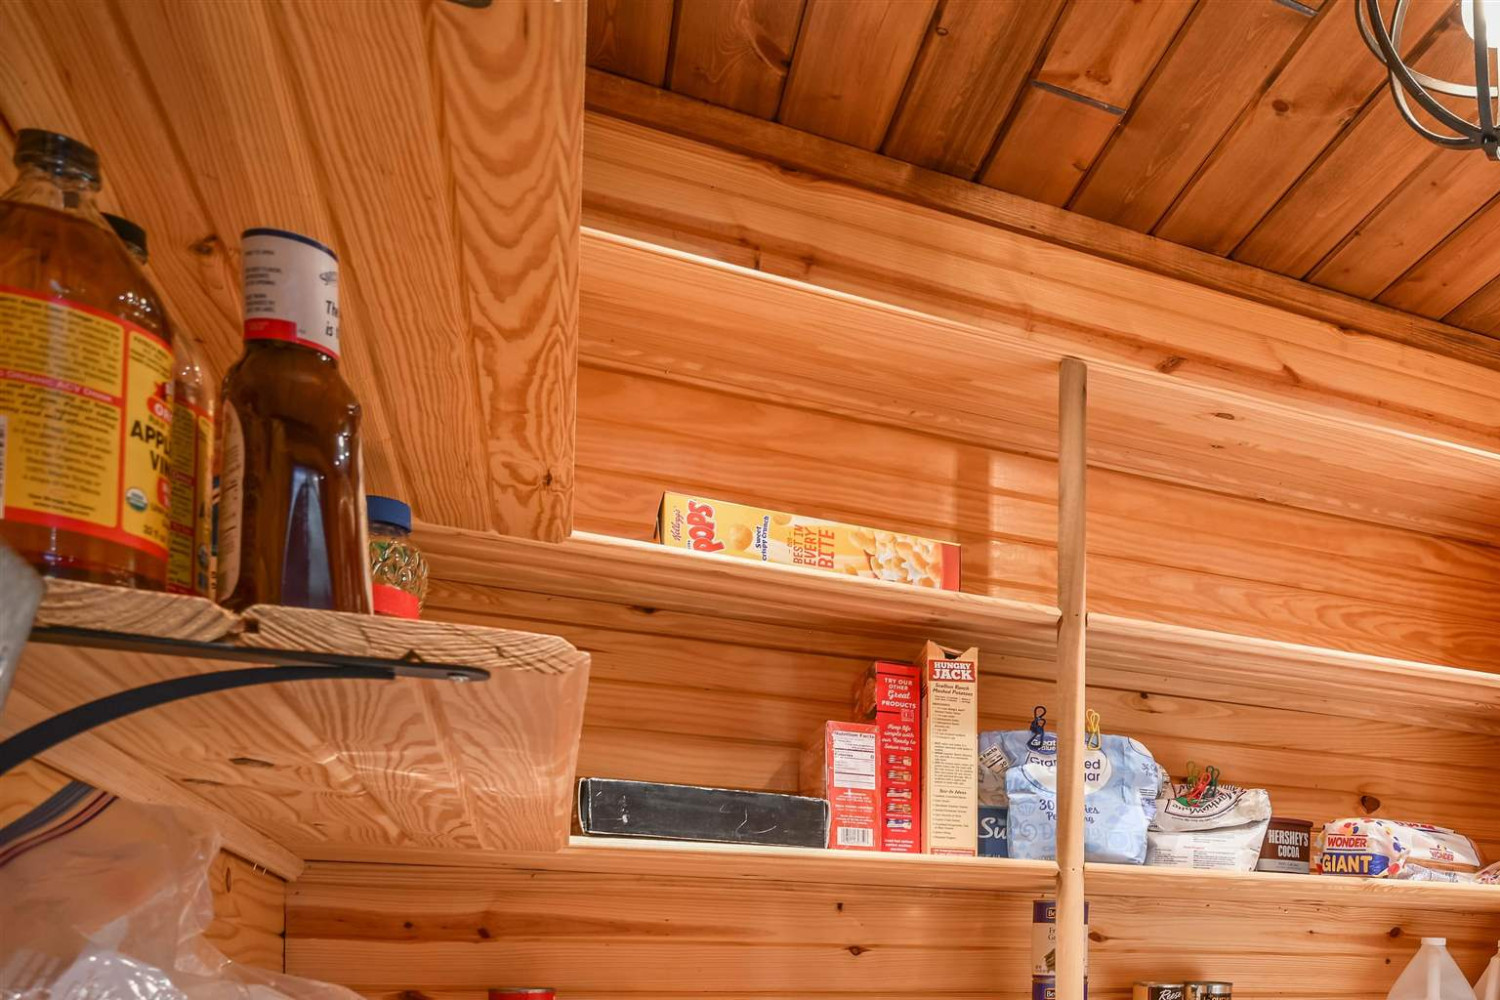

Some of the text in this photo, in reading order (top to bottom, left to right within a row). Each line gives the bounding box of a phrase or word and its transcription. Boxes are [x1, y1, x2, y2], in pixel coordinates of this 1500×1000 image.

[130, 419, 172, 456] APPL
[793, 542, 803, 564] BEST
[804, 527, 817, 566] EVERY
[818, 530, 835, 569] BITE
[933, 669, 974, 680] JACK
[882, 700, 916, 708] PRODUCTS
[1268, 829, 1309, 847] HERSHEY'S
[1327, 836, 1367, 848] WONDER
[1277, 845, 1300, 858] COCOA
[1322, 854, 1373, 873] GIANT
